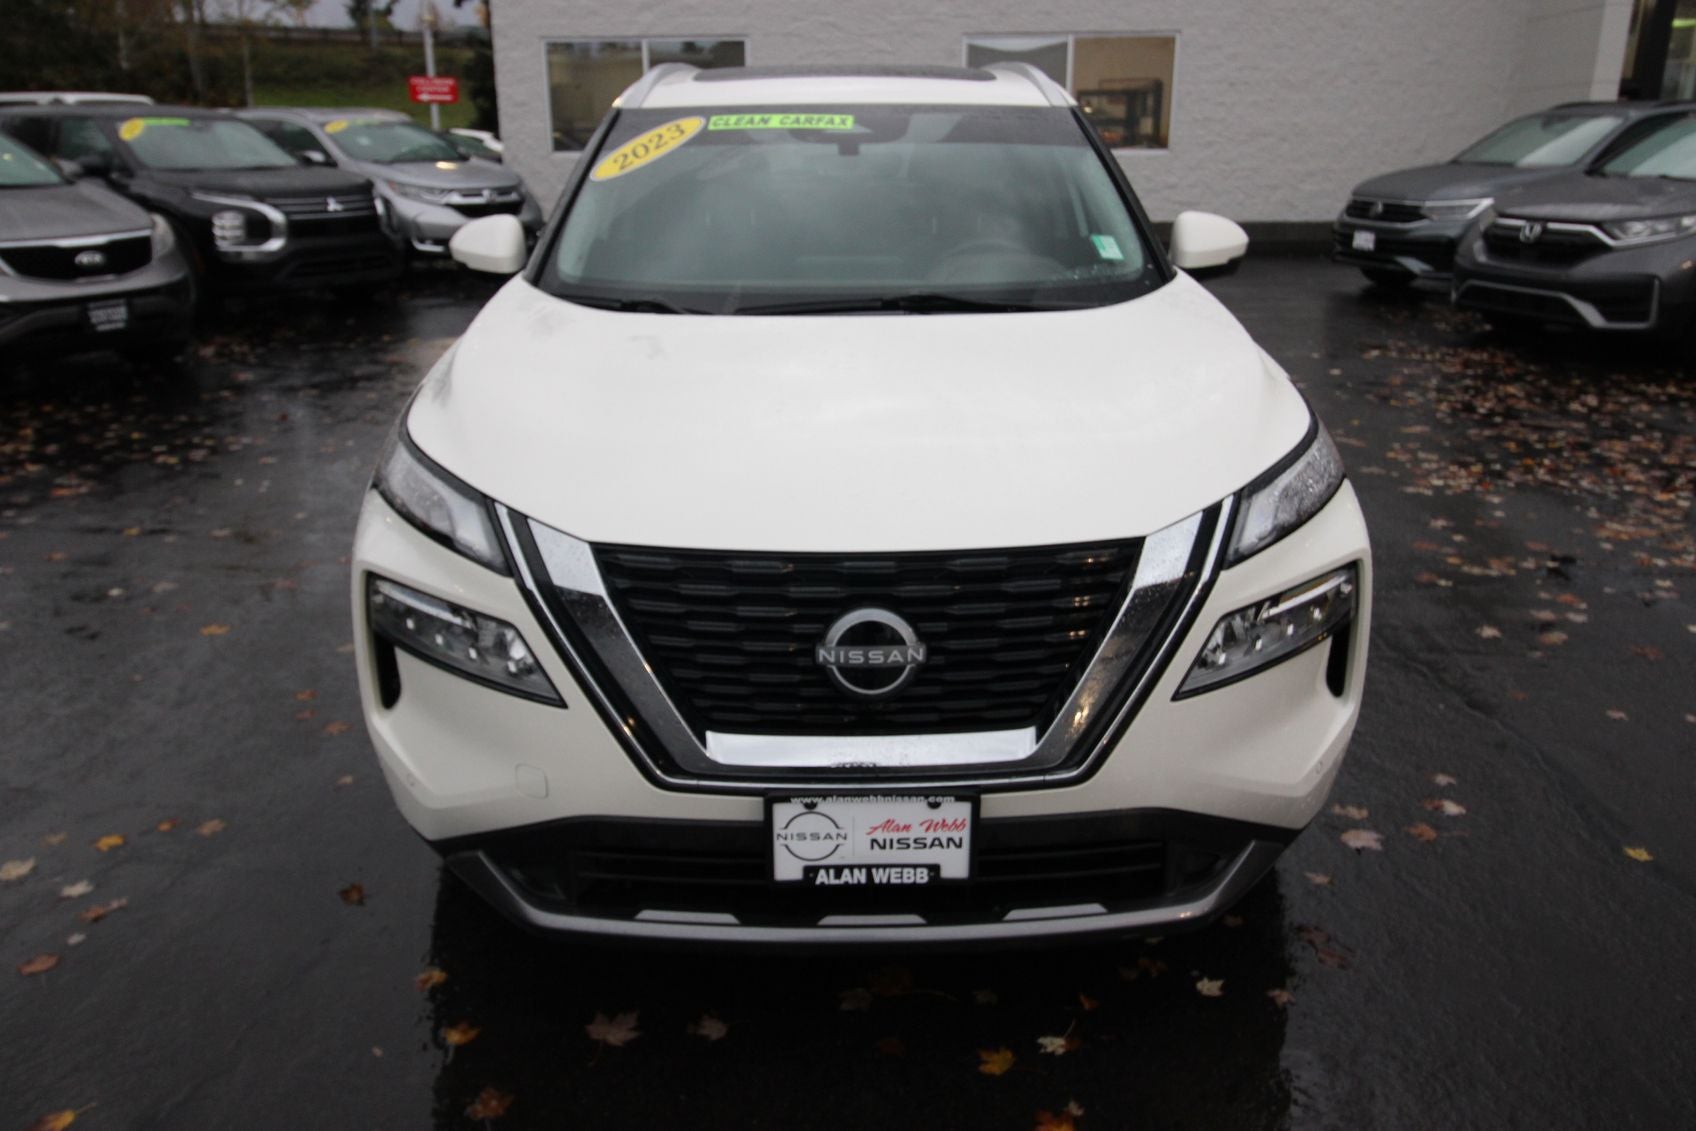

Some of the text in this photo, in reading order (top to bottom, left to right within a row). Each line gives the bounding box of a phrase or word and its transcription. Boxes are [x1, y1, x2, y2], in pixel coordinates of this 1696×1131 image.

[711, 115, 851, 128] CLEAN CARFAX
[611, 123, 686, 171] 2023
[818, 647, 924, 664] NISSAN
[866, 817, 968, 836] Alan Webb
[776, 832, 848, 842] NISSAN
[870, 837, 963, 851] NISSAN
[814, 867, 930, 886] ALAN WEBB
